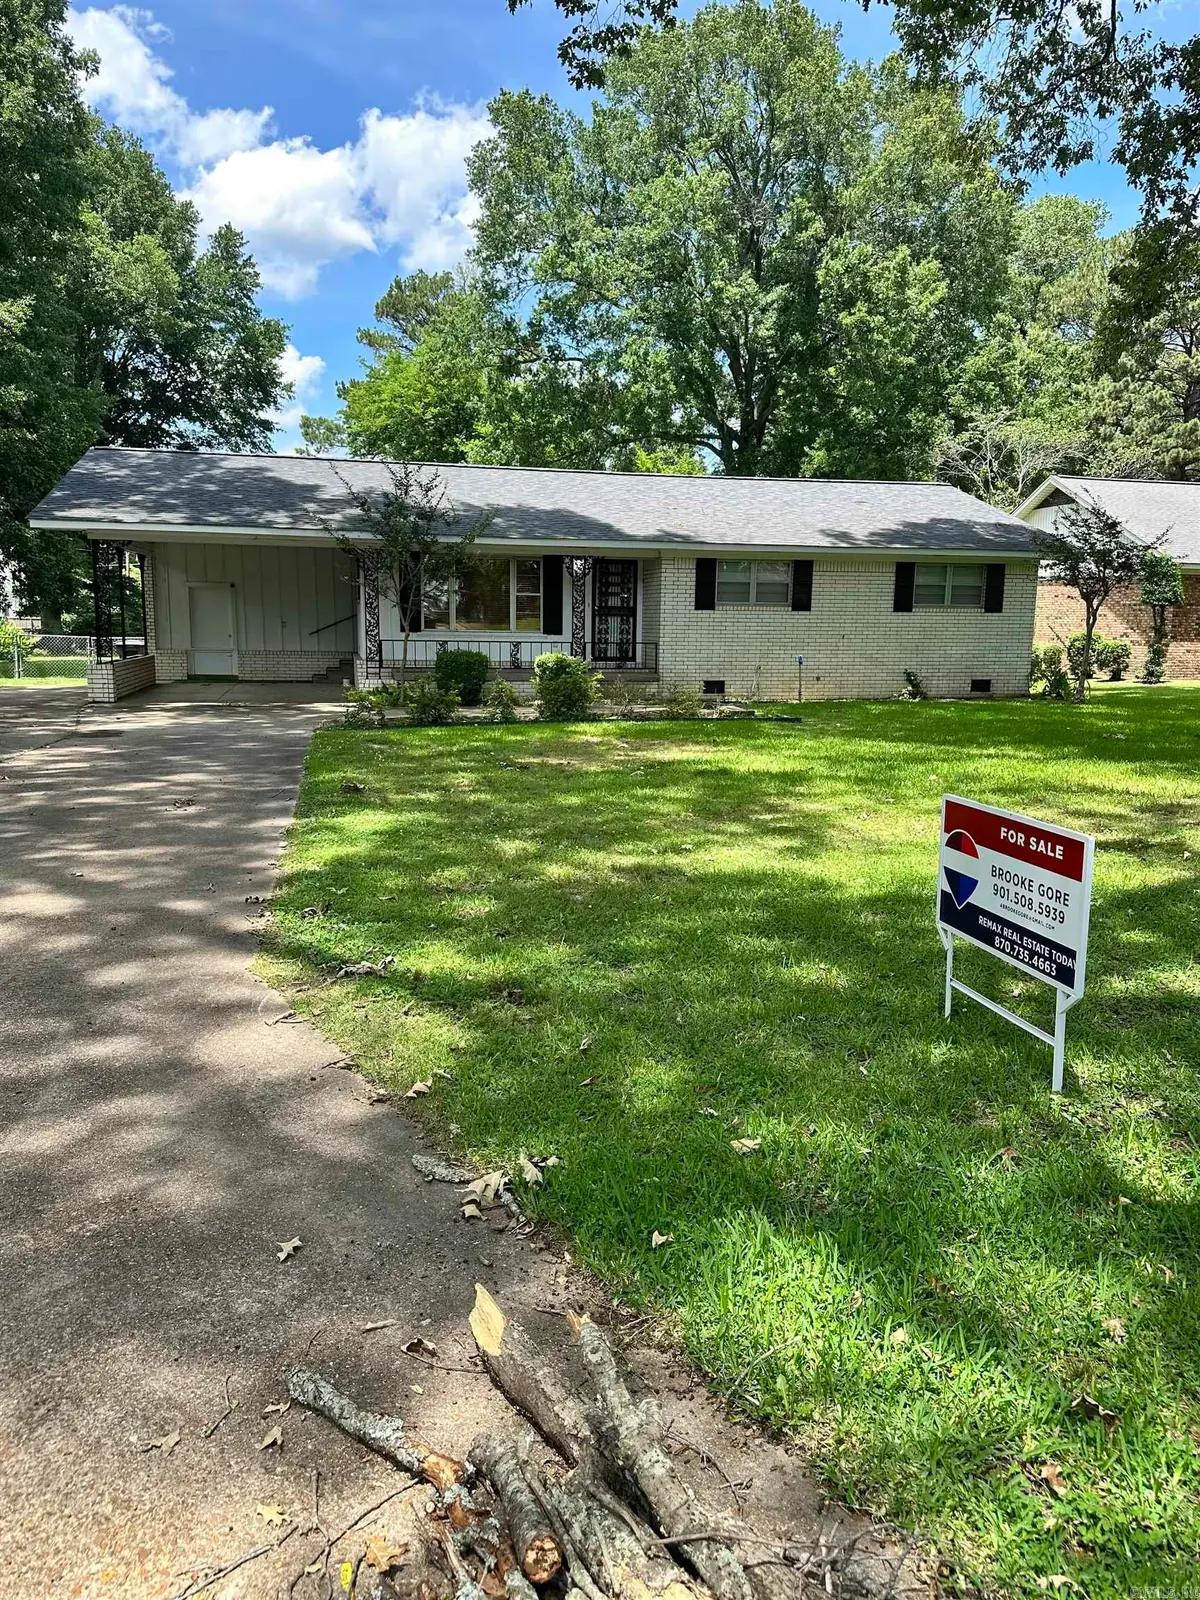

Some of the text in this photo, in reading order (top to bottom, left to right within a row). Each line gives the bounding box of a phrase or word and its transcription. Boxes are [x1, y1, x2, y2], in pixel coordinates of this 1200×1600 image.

[1000, 827, 1064, 860] FOR SALE
[991, 865, 1070, 907] BROOKE GORE
[992, 883, 1065, 924] 901.508.5939
[978, 915, 1002, 935] REMAX
[1003, 927, 1022, 944] REAL
[1023, 936, 1050, 957] ESTATE
[994, 936, 1057, 976] 870.735.4663
